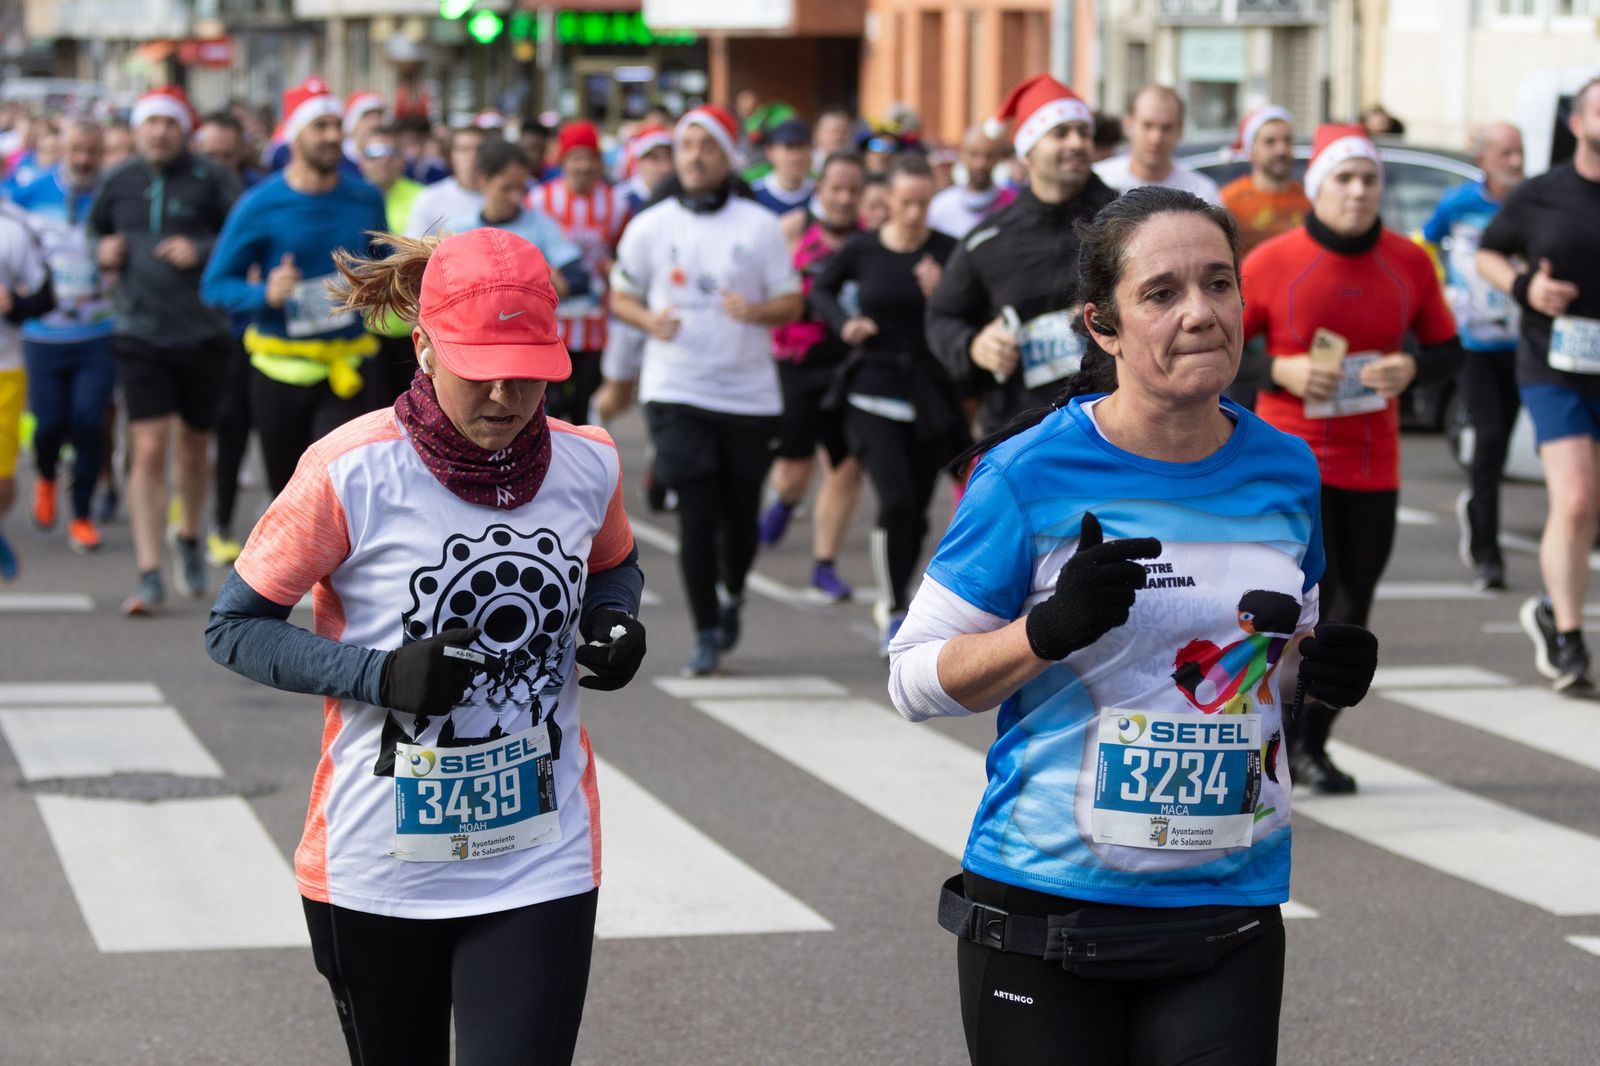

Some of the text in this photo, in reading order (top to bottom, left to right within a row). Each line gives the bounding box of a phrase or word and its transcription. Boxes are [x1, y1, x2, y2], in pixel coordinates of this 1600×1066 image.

[1143, 562, 1174, 574] STRE
[1144, 576, 1196, 589] ANTINA
[1151, 721, 1249, 744] SETEL
[440, 737, 537, 774] SETEL
[1120, 748, 1228, 805] 3234
[418, 767, 521, 825] 3439
[1161, 804, 1189, 816] MACA
[459, 822, 487, 833] MOAH
[1171, 827, 1214, 837] Ayuntamiento
[471, 835, 515, 849] Ayuntamiento
[1171, 838, 1212, 846] de Salamanca
[481, 844, 515, 856] Salamanca
[993, 989, 1034, 1005] ARTENGO
